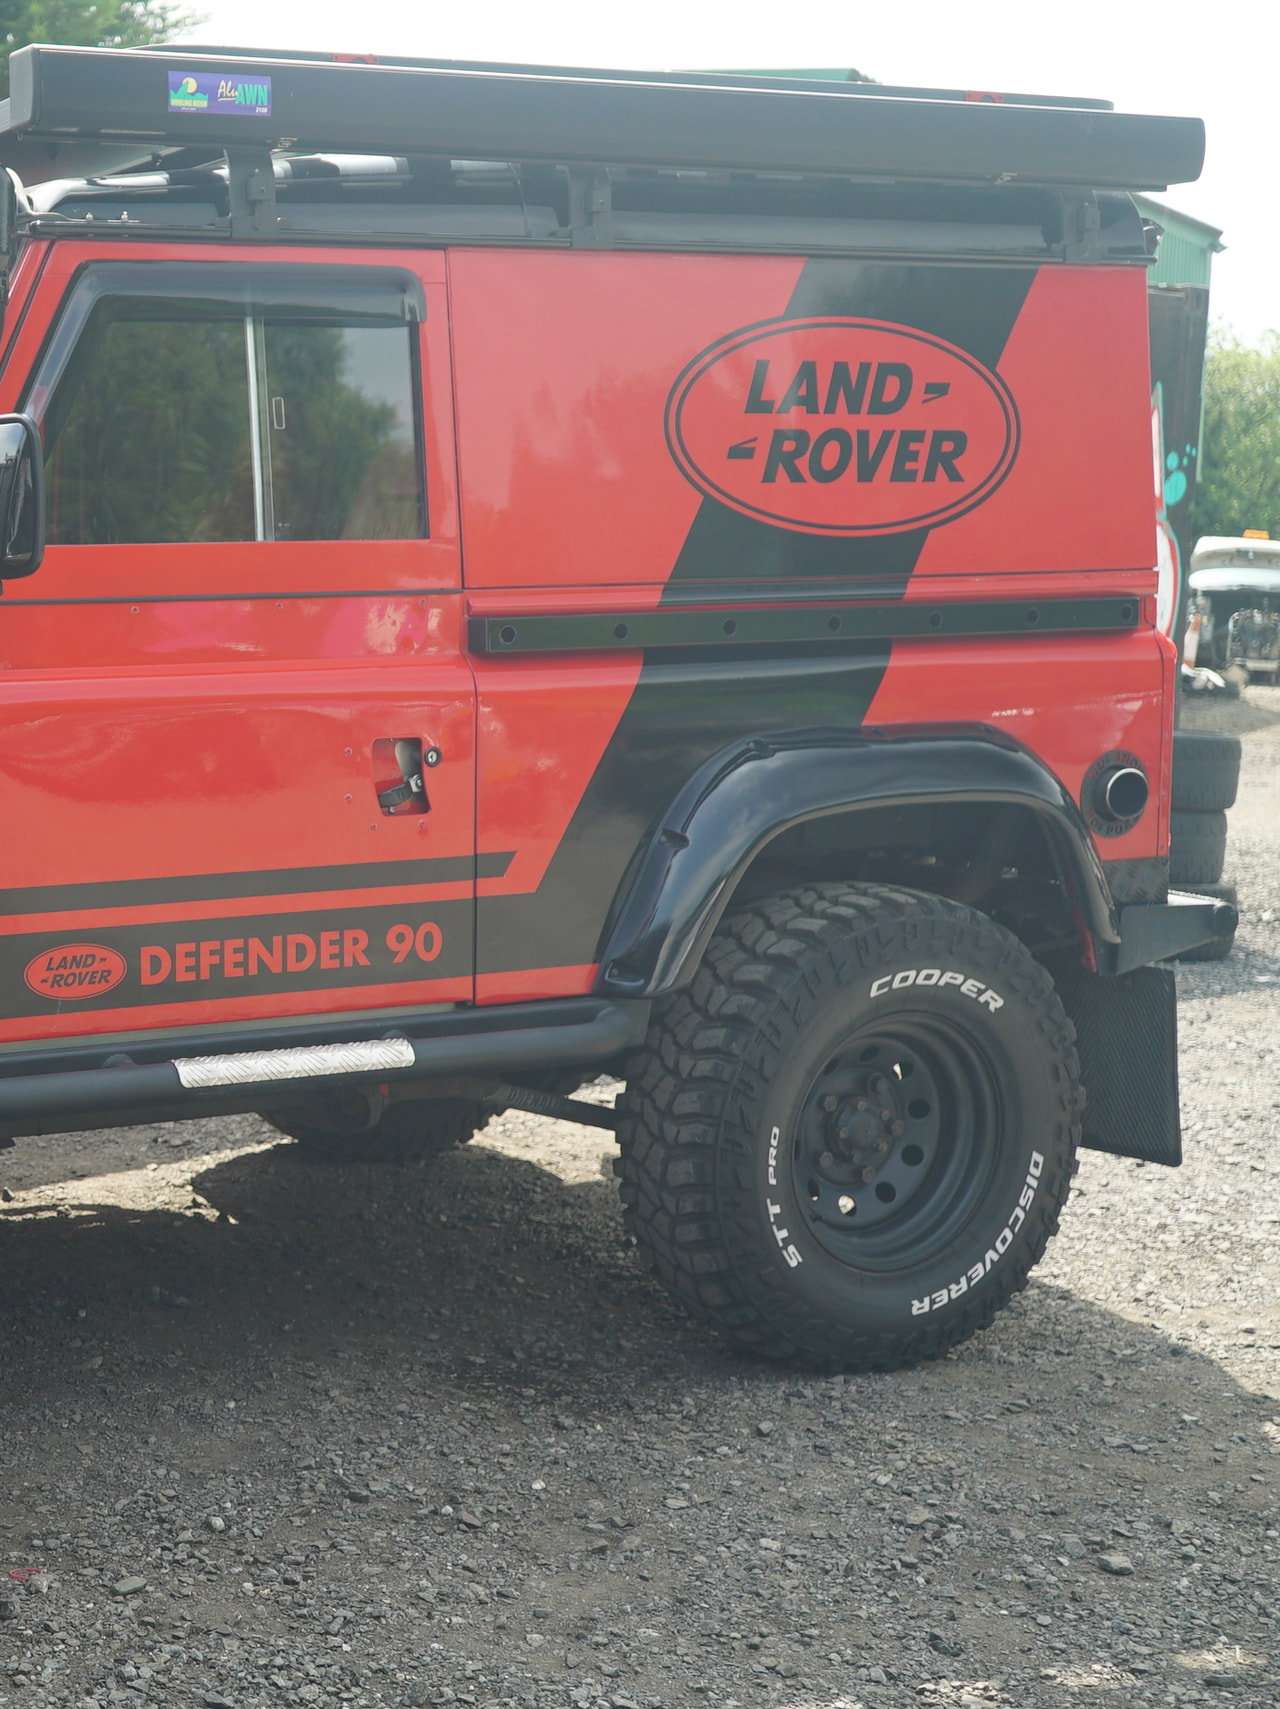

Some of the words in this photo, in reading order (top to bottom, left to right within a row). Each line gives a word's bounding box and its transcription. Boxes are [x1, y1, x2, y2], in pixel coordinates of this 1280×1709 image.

[744, 360, 914, 415] LAND
[760, 427, 969, 483] ROVER
[46, 954, 97, 971] LAND
[50, 969, 113, 989] ROVER
[139, 928, 371, 986] DEFENDER
[385, 921, 443, 964] 90
[870, 968, 1005, 1013] COOPER
[768, 1125, 780, 1186] PRO
[766, 1197, 803, 1268] STT
[911, 1150, 1045, 1316] DISCOVERER
